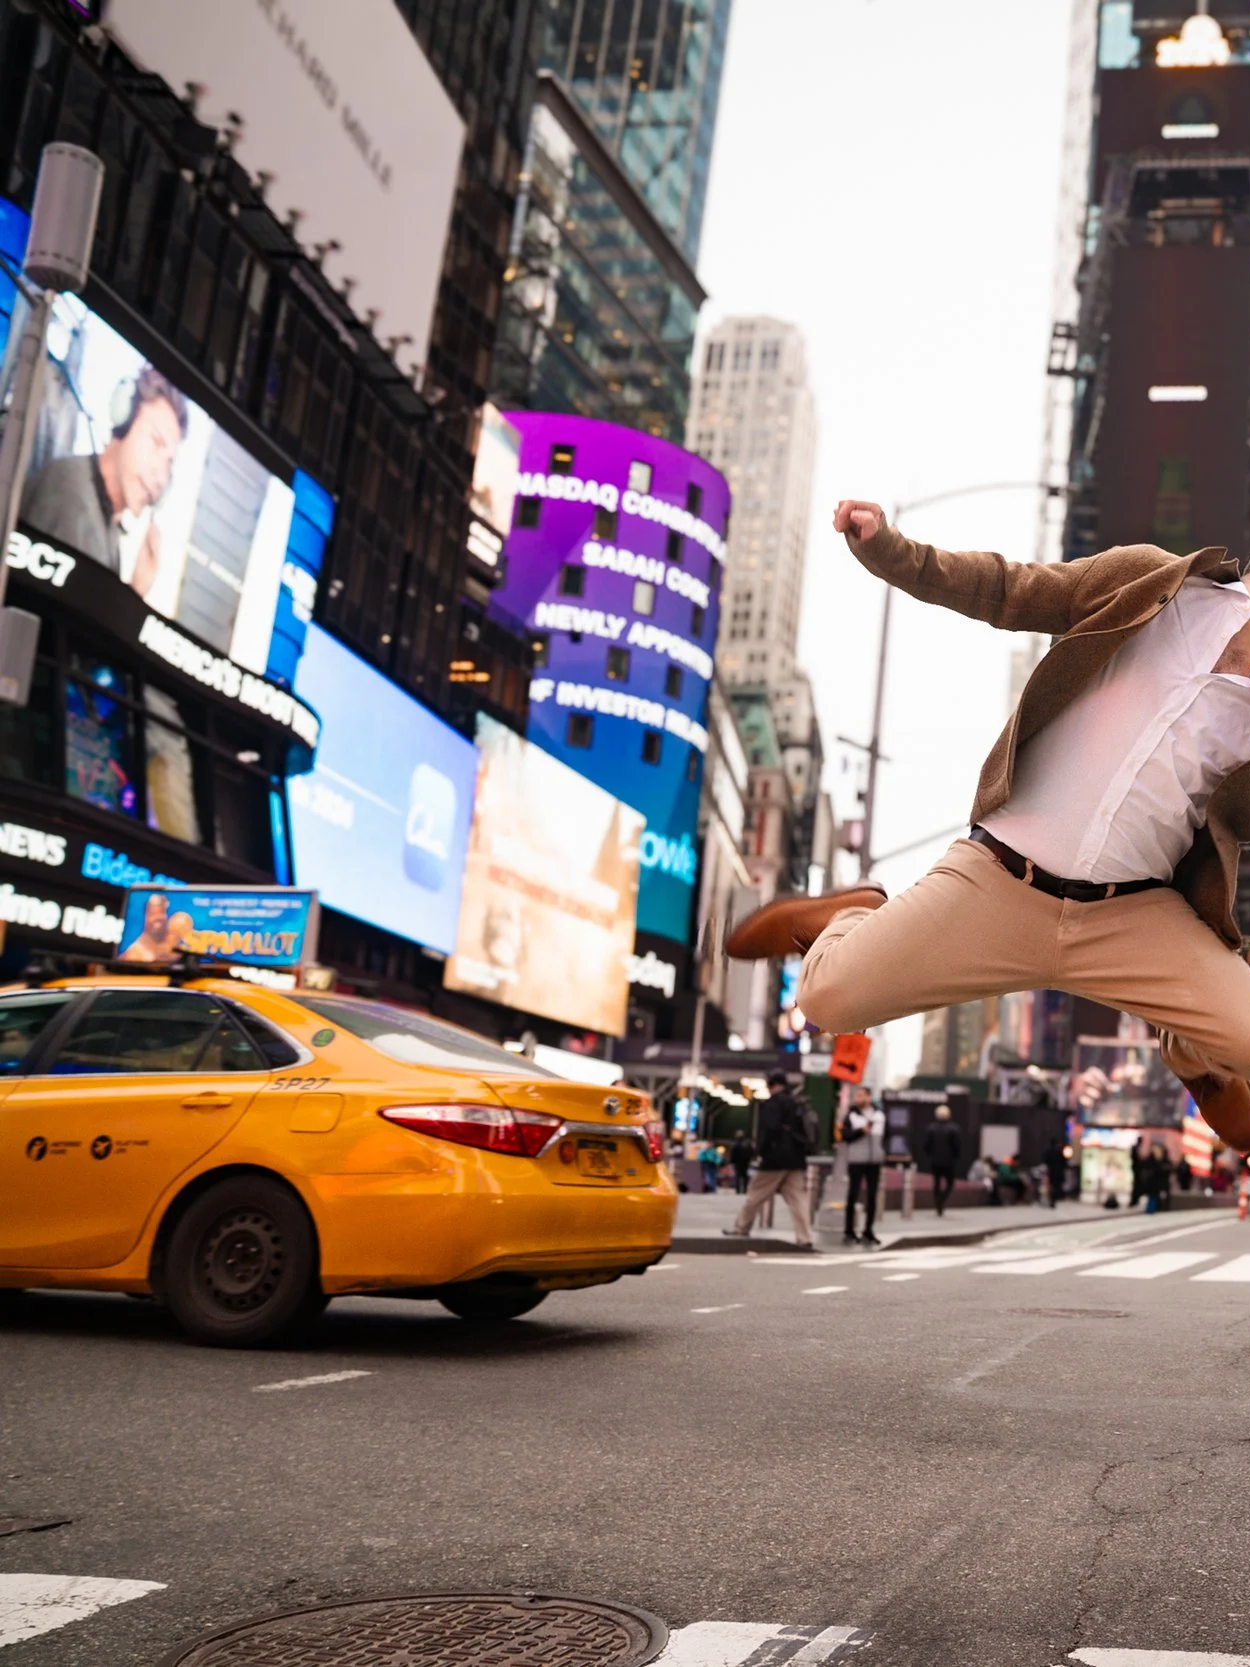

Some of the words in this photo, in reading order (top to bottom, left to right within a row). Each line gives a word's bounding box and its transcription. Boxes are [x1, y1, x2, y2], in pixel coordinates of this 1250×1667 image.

[516, 472, 619, 513] NASDAQ
[582, 541, 666, 585] SARAH
[534, 602, 627, 640] NEWLY
[556, 681, 666, 728] INVESTOR
